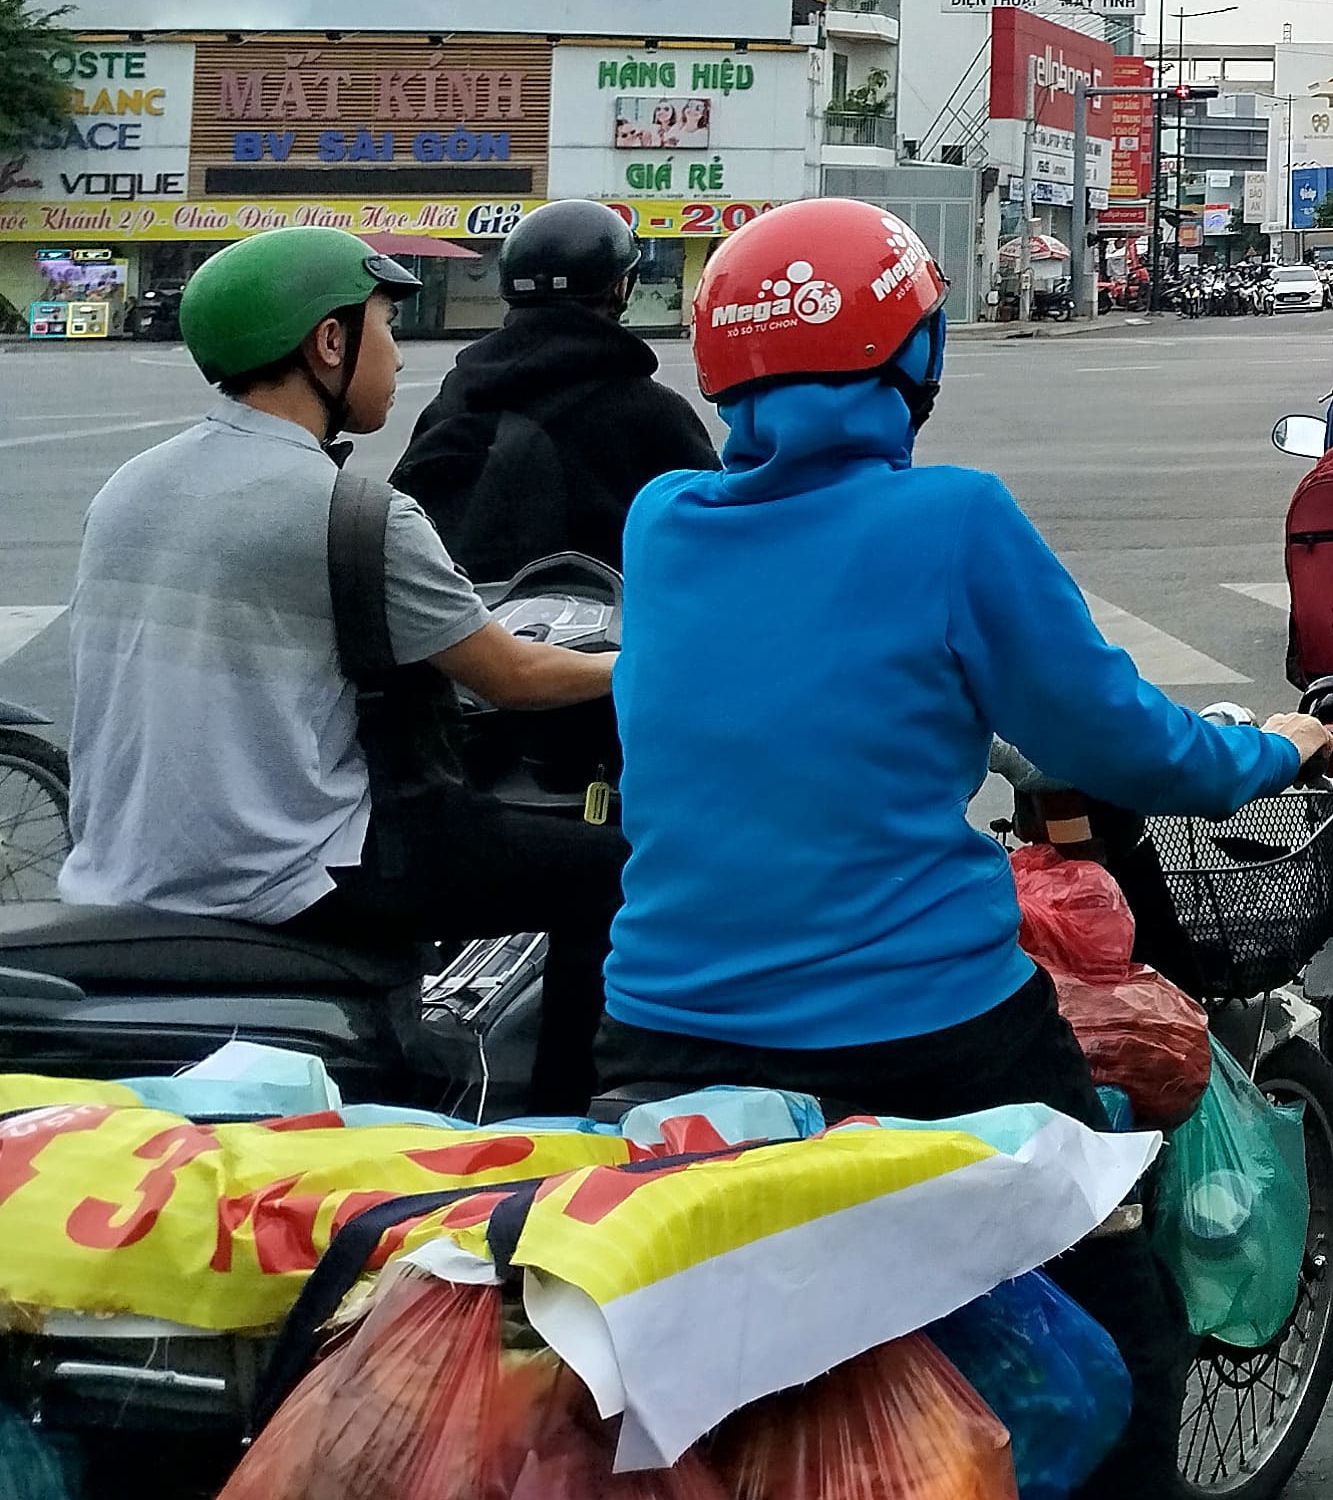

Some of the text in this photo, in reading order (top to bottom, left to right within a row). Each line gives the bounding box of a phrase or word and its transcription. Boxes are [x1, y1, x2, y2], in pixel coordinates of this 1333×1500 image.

[373, 52, 527, 119] KÍNH
[598, 55, 755, 97] HÀNG HIỆU
[232, 124, 511, 162] BV SÀI GÒN
[60, 173, 184, 202] VOGUE
[625, 156, 724, 192] GIÁ RẺ
[40, 206, 111, 231] Khánh
[119, 206, 155, 235] 2/9
[173, 205, 229, 231] Chào
[235, 206, 287, 230] Đón
[293, 206, 353, 229] Năm
[361, 206, 408, 233] Học
[412, 205, 458, 228] Mới
[467, 203, 523, 235] Giả
[871, 247, 917, 301] Mega
[712, 299, 791, 327] Mega
[820, 299, 837, 314] 45
